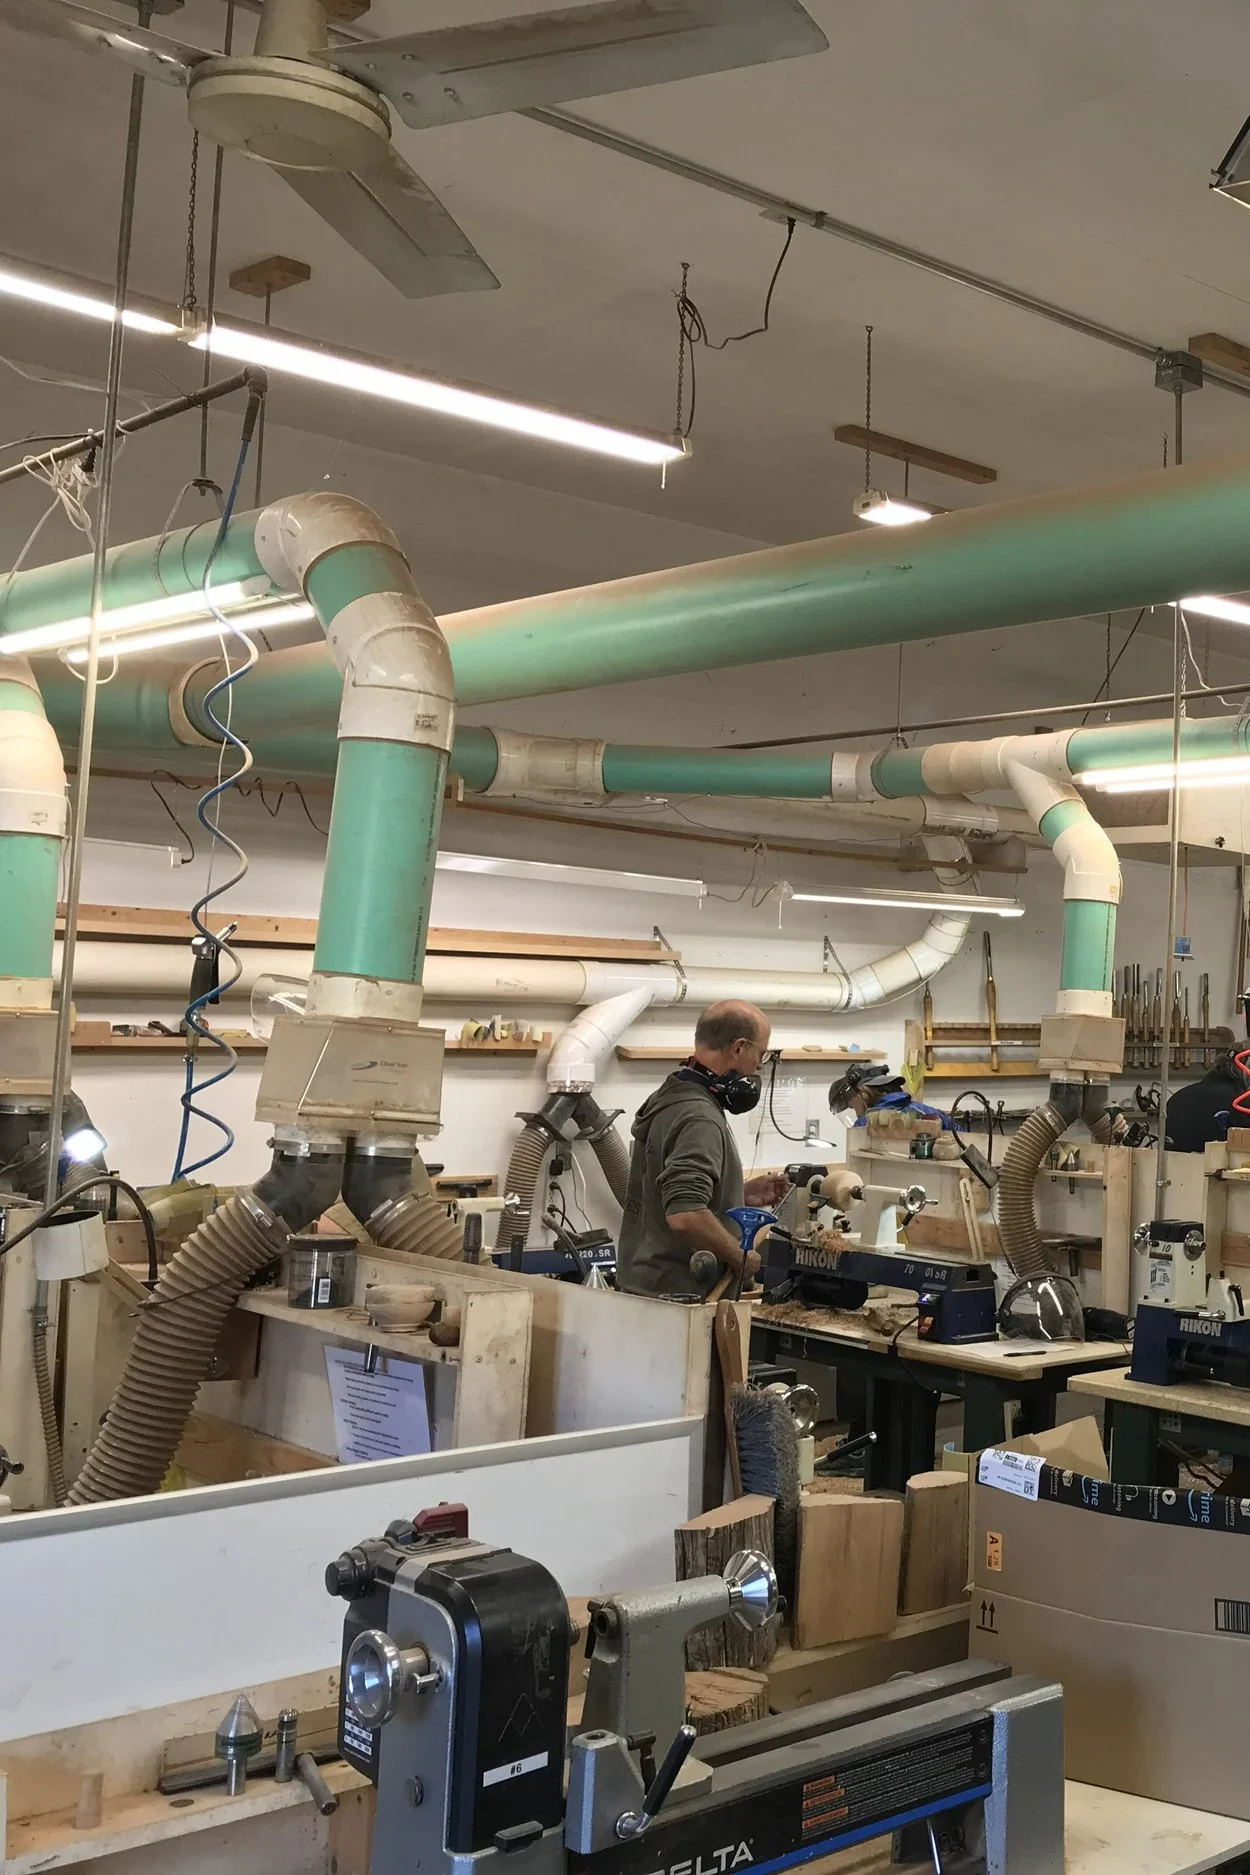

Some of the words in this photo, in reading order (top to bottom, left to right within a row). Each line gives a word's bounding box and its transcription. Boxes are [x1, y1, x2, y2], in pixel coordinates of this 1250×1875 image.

[1179, 1317, 1223, 1337] RIKON
[1090, 1479, 1103, 1507] ime
[1201, 1490, 1214, 1524] rime
[510, 1763, 522, 1775] #6
[647, 1841, 754, 1875] ELTA
